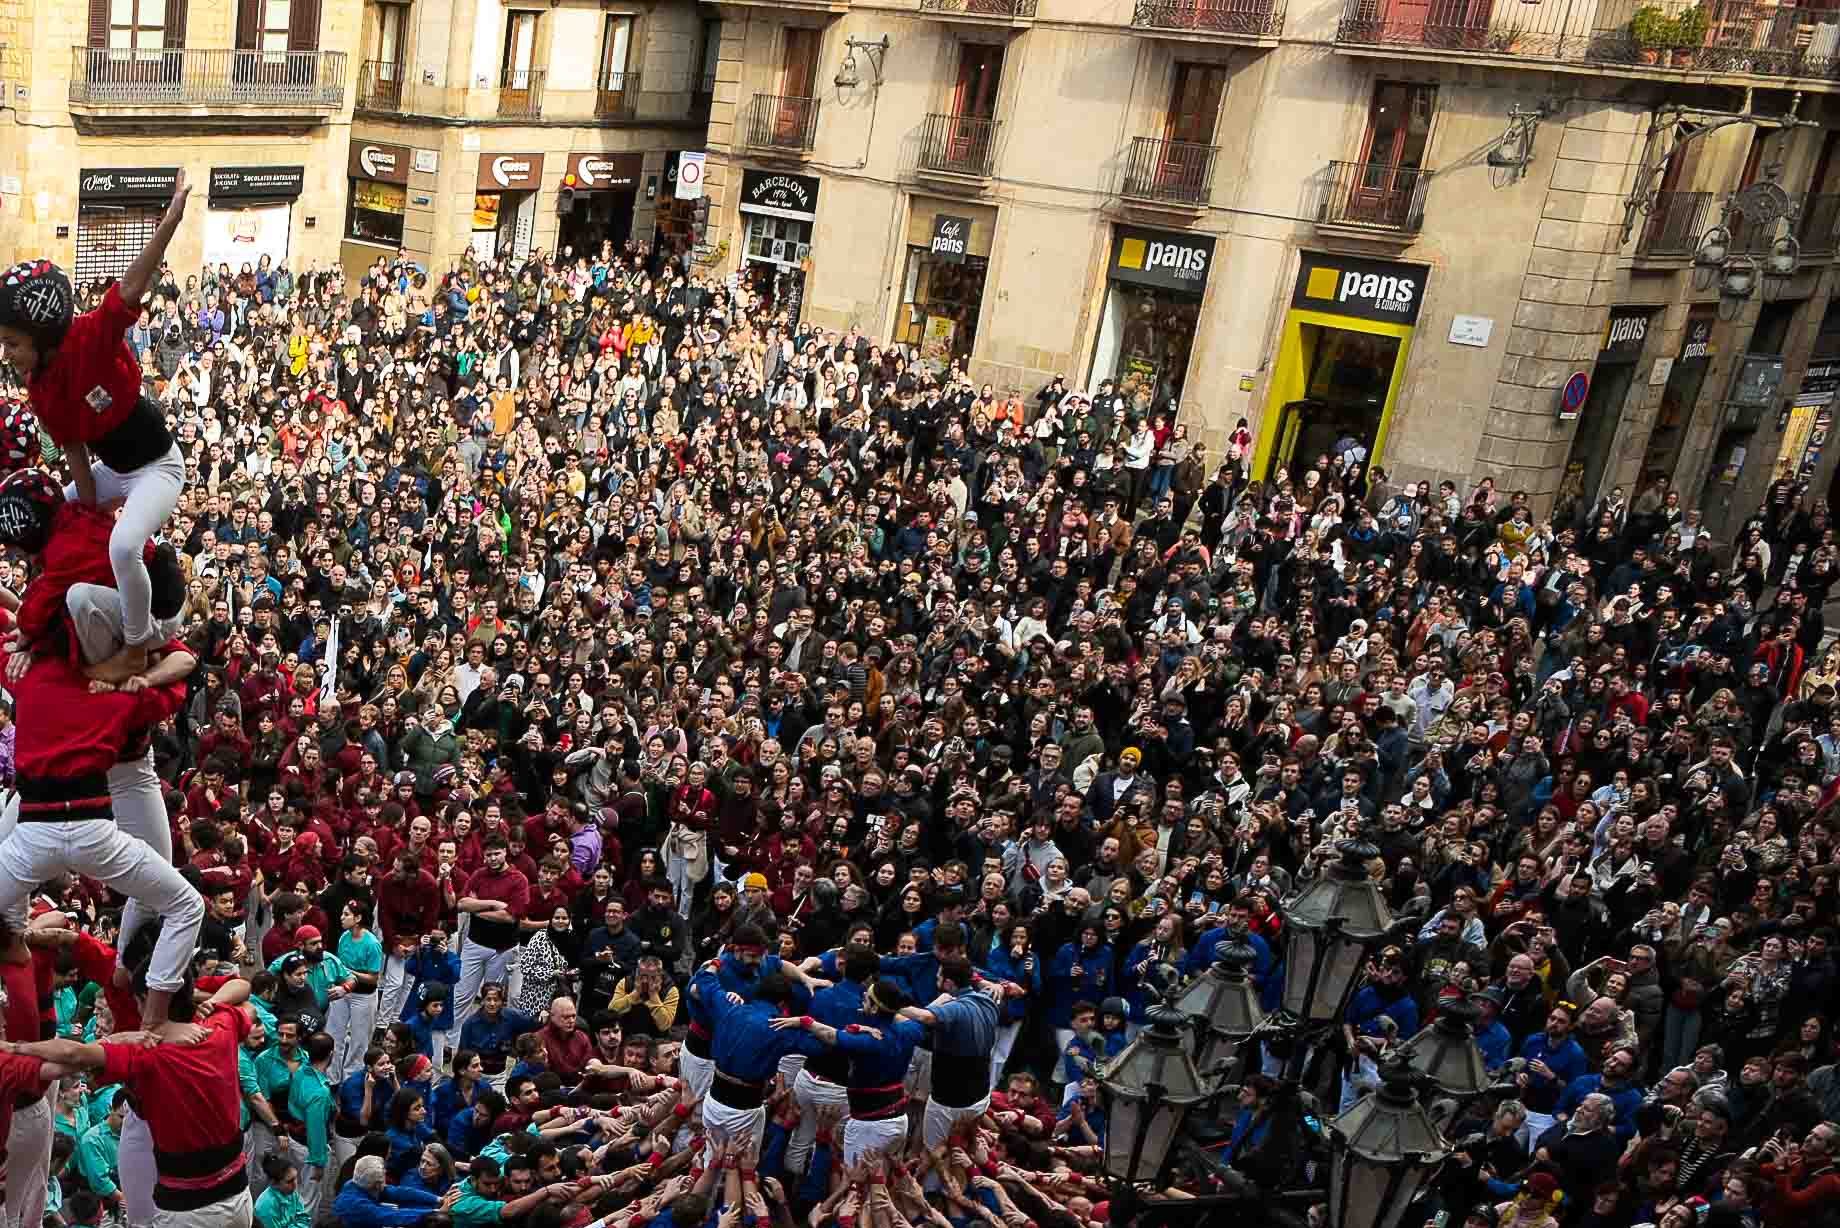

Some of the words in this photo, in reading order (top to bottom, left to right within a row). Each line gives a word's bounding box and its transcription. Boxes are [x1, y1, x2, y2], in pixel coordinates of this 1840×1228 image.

[752, 176, 808, 207] BARCELONA
[931, 236, 964, 254] pans
[1144, 241, 1207, 272] pans
[1339, 270, 1416, 303] pans
[1381, 299, 1410, 313] COMPANY
[1607, 317, 1647, 350] pans
[1683, 342, 1708, 363] pans
